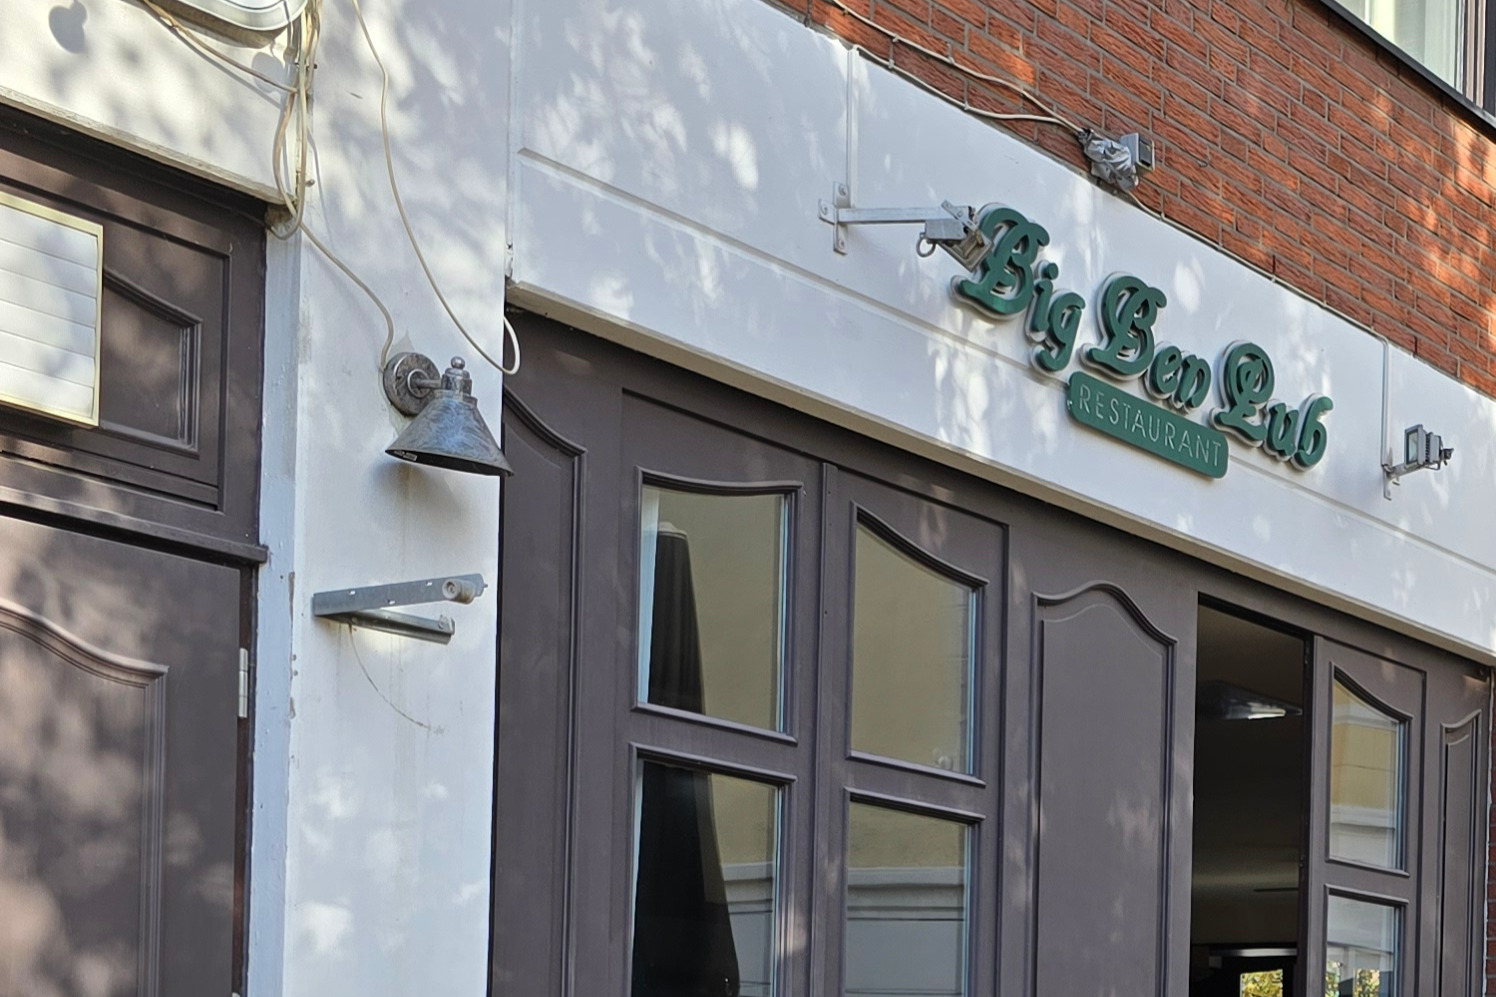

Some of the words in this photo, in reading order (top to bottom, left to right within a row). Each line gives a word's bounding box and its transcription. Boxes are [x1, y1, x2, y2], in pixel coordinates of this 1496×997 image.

[957, 206, 1085, 371] Big
[1085, 276, 1212, 408] Ben
[1214, 343, 1334, 468] Pub
[1077, 383, 1223, 469] RESTAURANT
